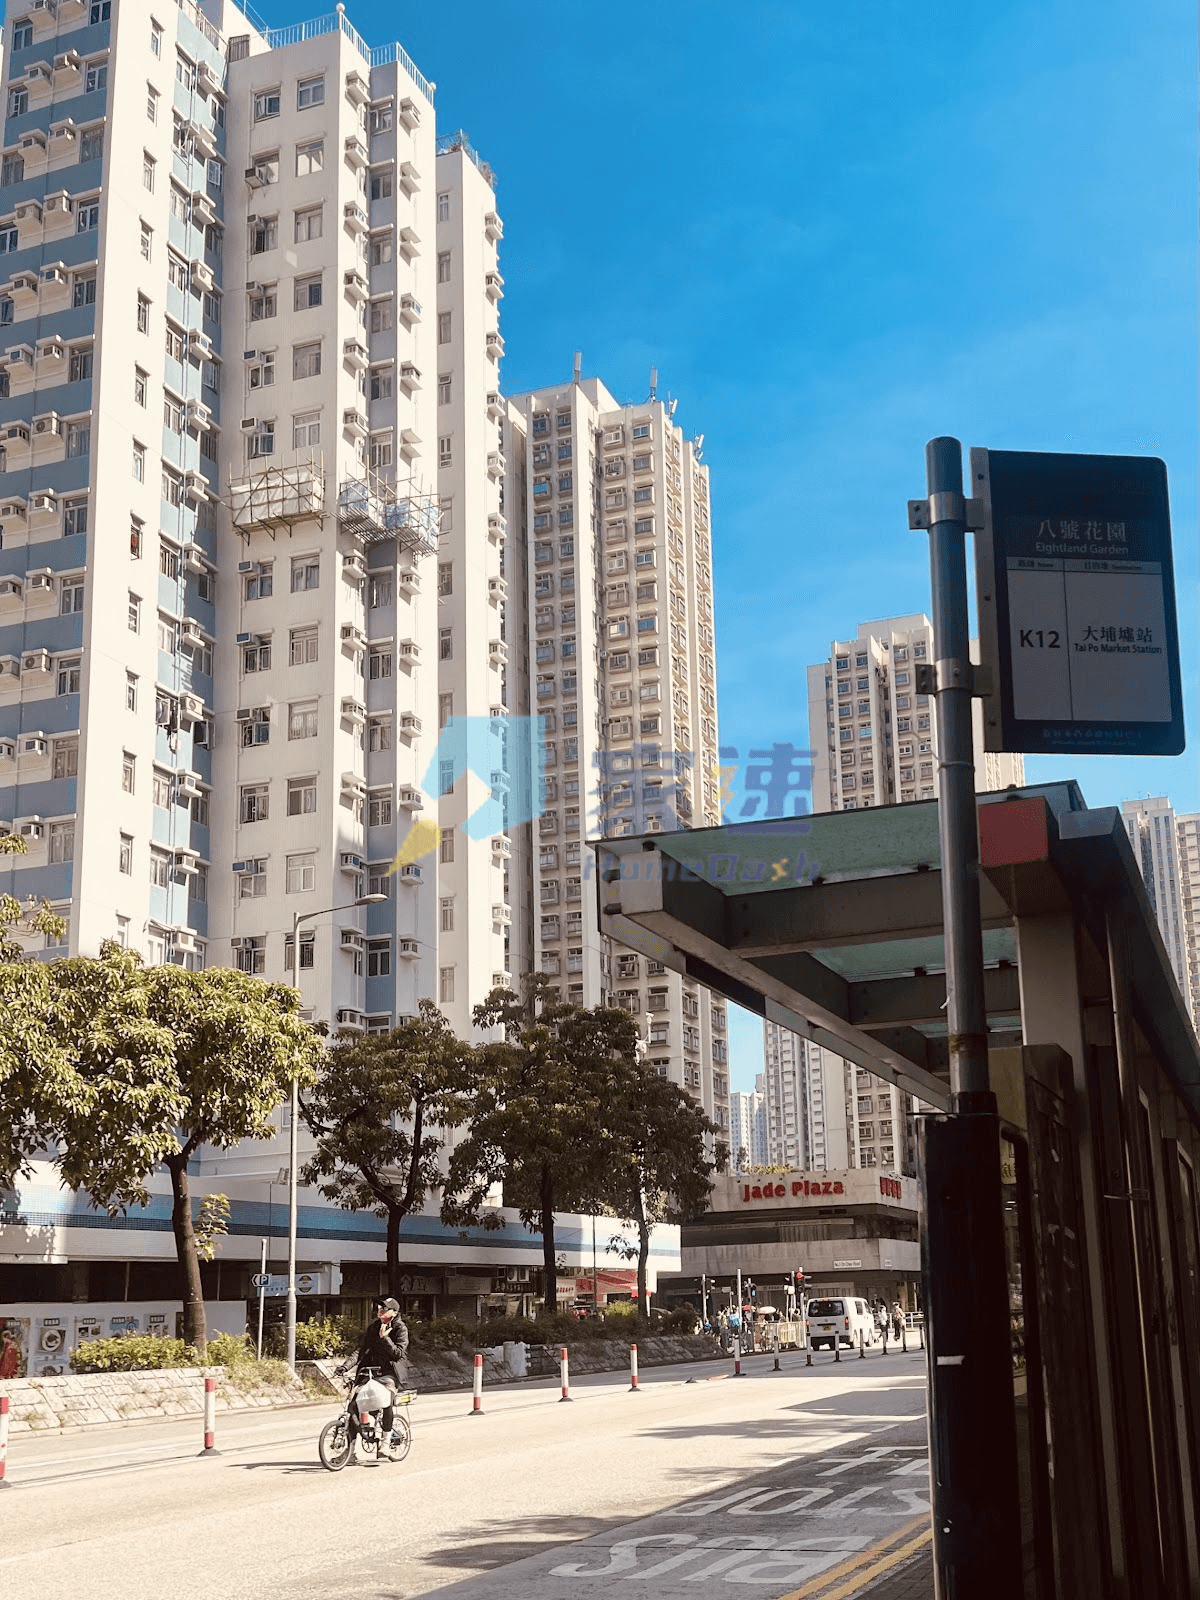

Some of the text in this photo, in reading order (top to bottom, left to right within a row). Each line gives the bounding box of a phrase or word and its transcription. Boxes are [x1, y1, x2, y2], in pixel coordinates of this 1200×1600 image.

[1036, 519, 1127, 542] 八號花園
[1035, 542, 1129, 556] Eightland Garden
[1019, 629, 1060, 649] K12
[1082, 624, 1153, 644] 大埔墟站
[1074, 643, 1162, 655] Tai Po Market Station
[743, 1180, 844, 1202] Jade Plaza
[261, 1276, 267, 1285] P
[548, 1534, 873, 1584] BUS
